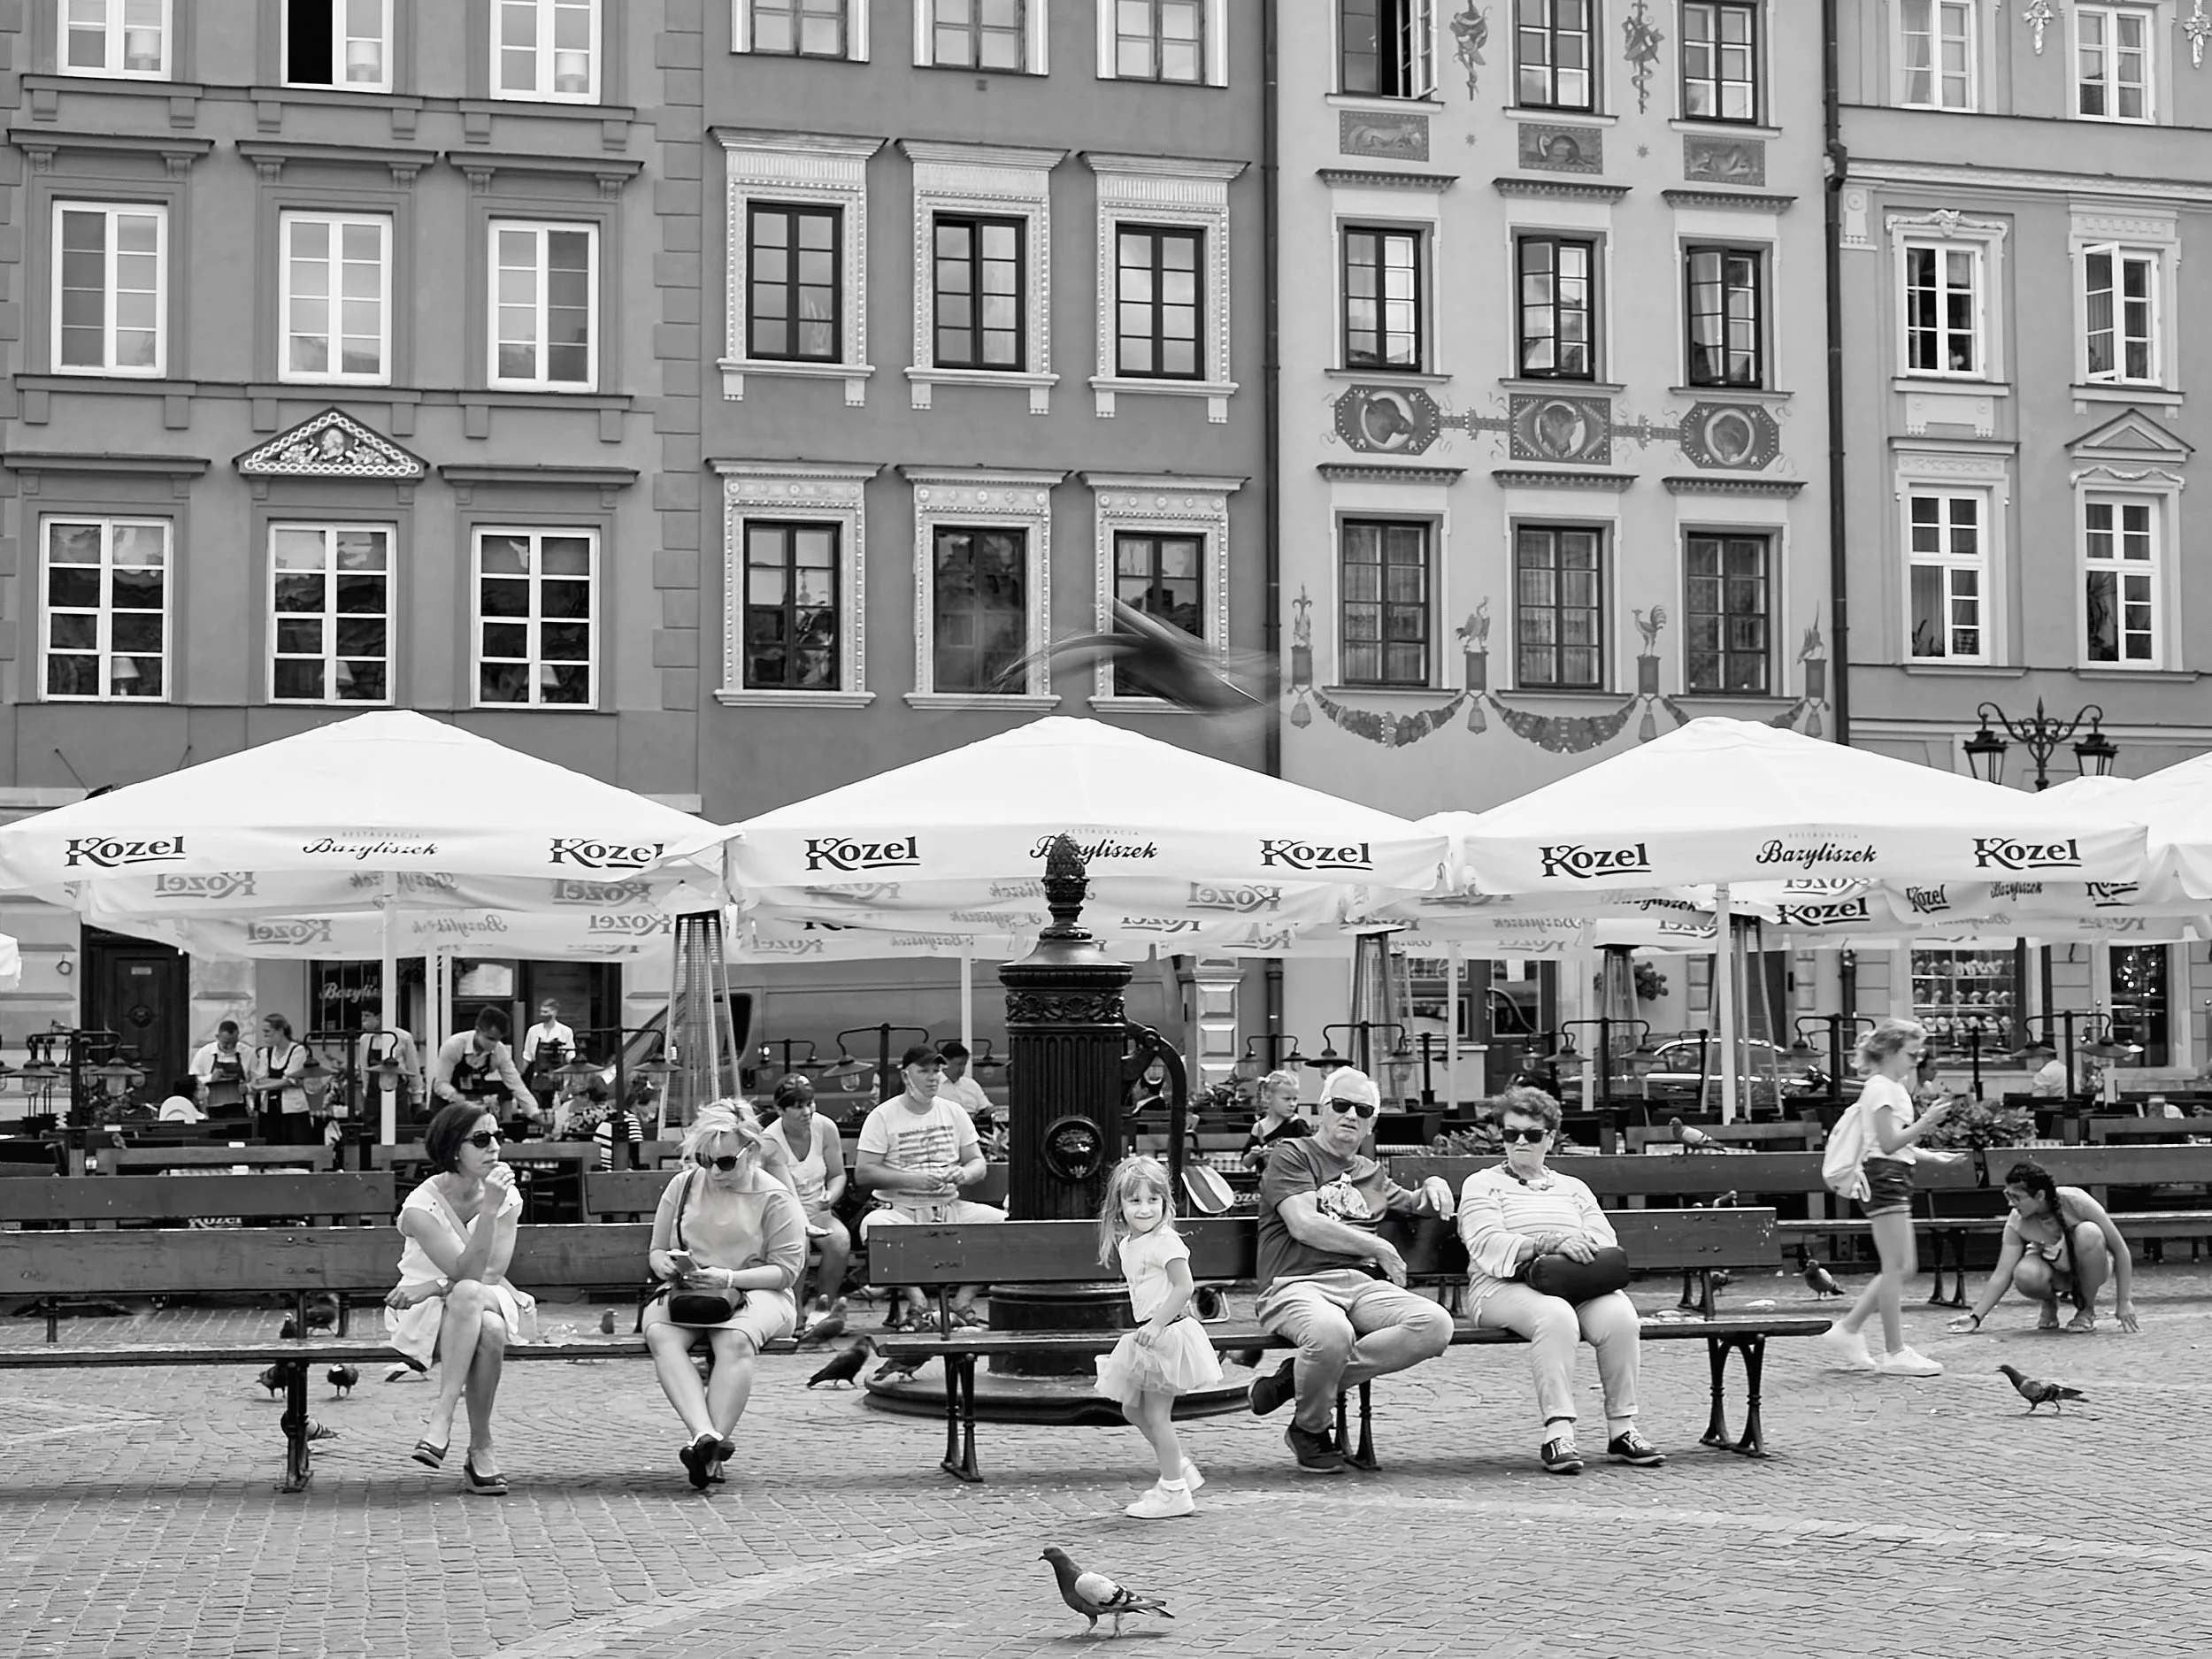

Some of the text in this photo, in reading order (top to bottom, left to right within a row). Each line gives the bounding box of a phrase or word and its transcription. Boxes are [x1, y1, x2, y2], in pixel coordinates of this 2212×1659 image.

[64, 836, 186, 868] Kozel
[303, 838, 439, 861] Bazyliszek
[803, 836, 921, 872] Kozel
[1029, 835, 1158, 865] Byliszek
[1259, 839, 1373, 871] Kozel
[1539, 843, 1652, 879] Kozel
[1755, 839, 1878, 870] Bazyliszek
[1971, 837, 2082, 870] Kozel
[1776, 897, 1871, 926] Kozel
[1905, 884, 1951, 914] Kozel
